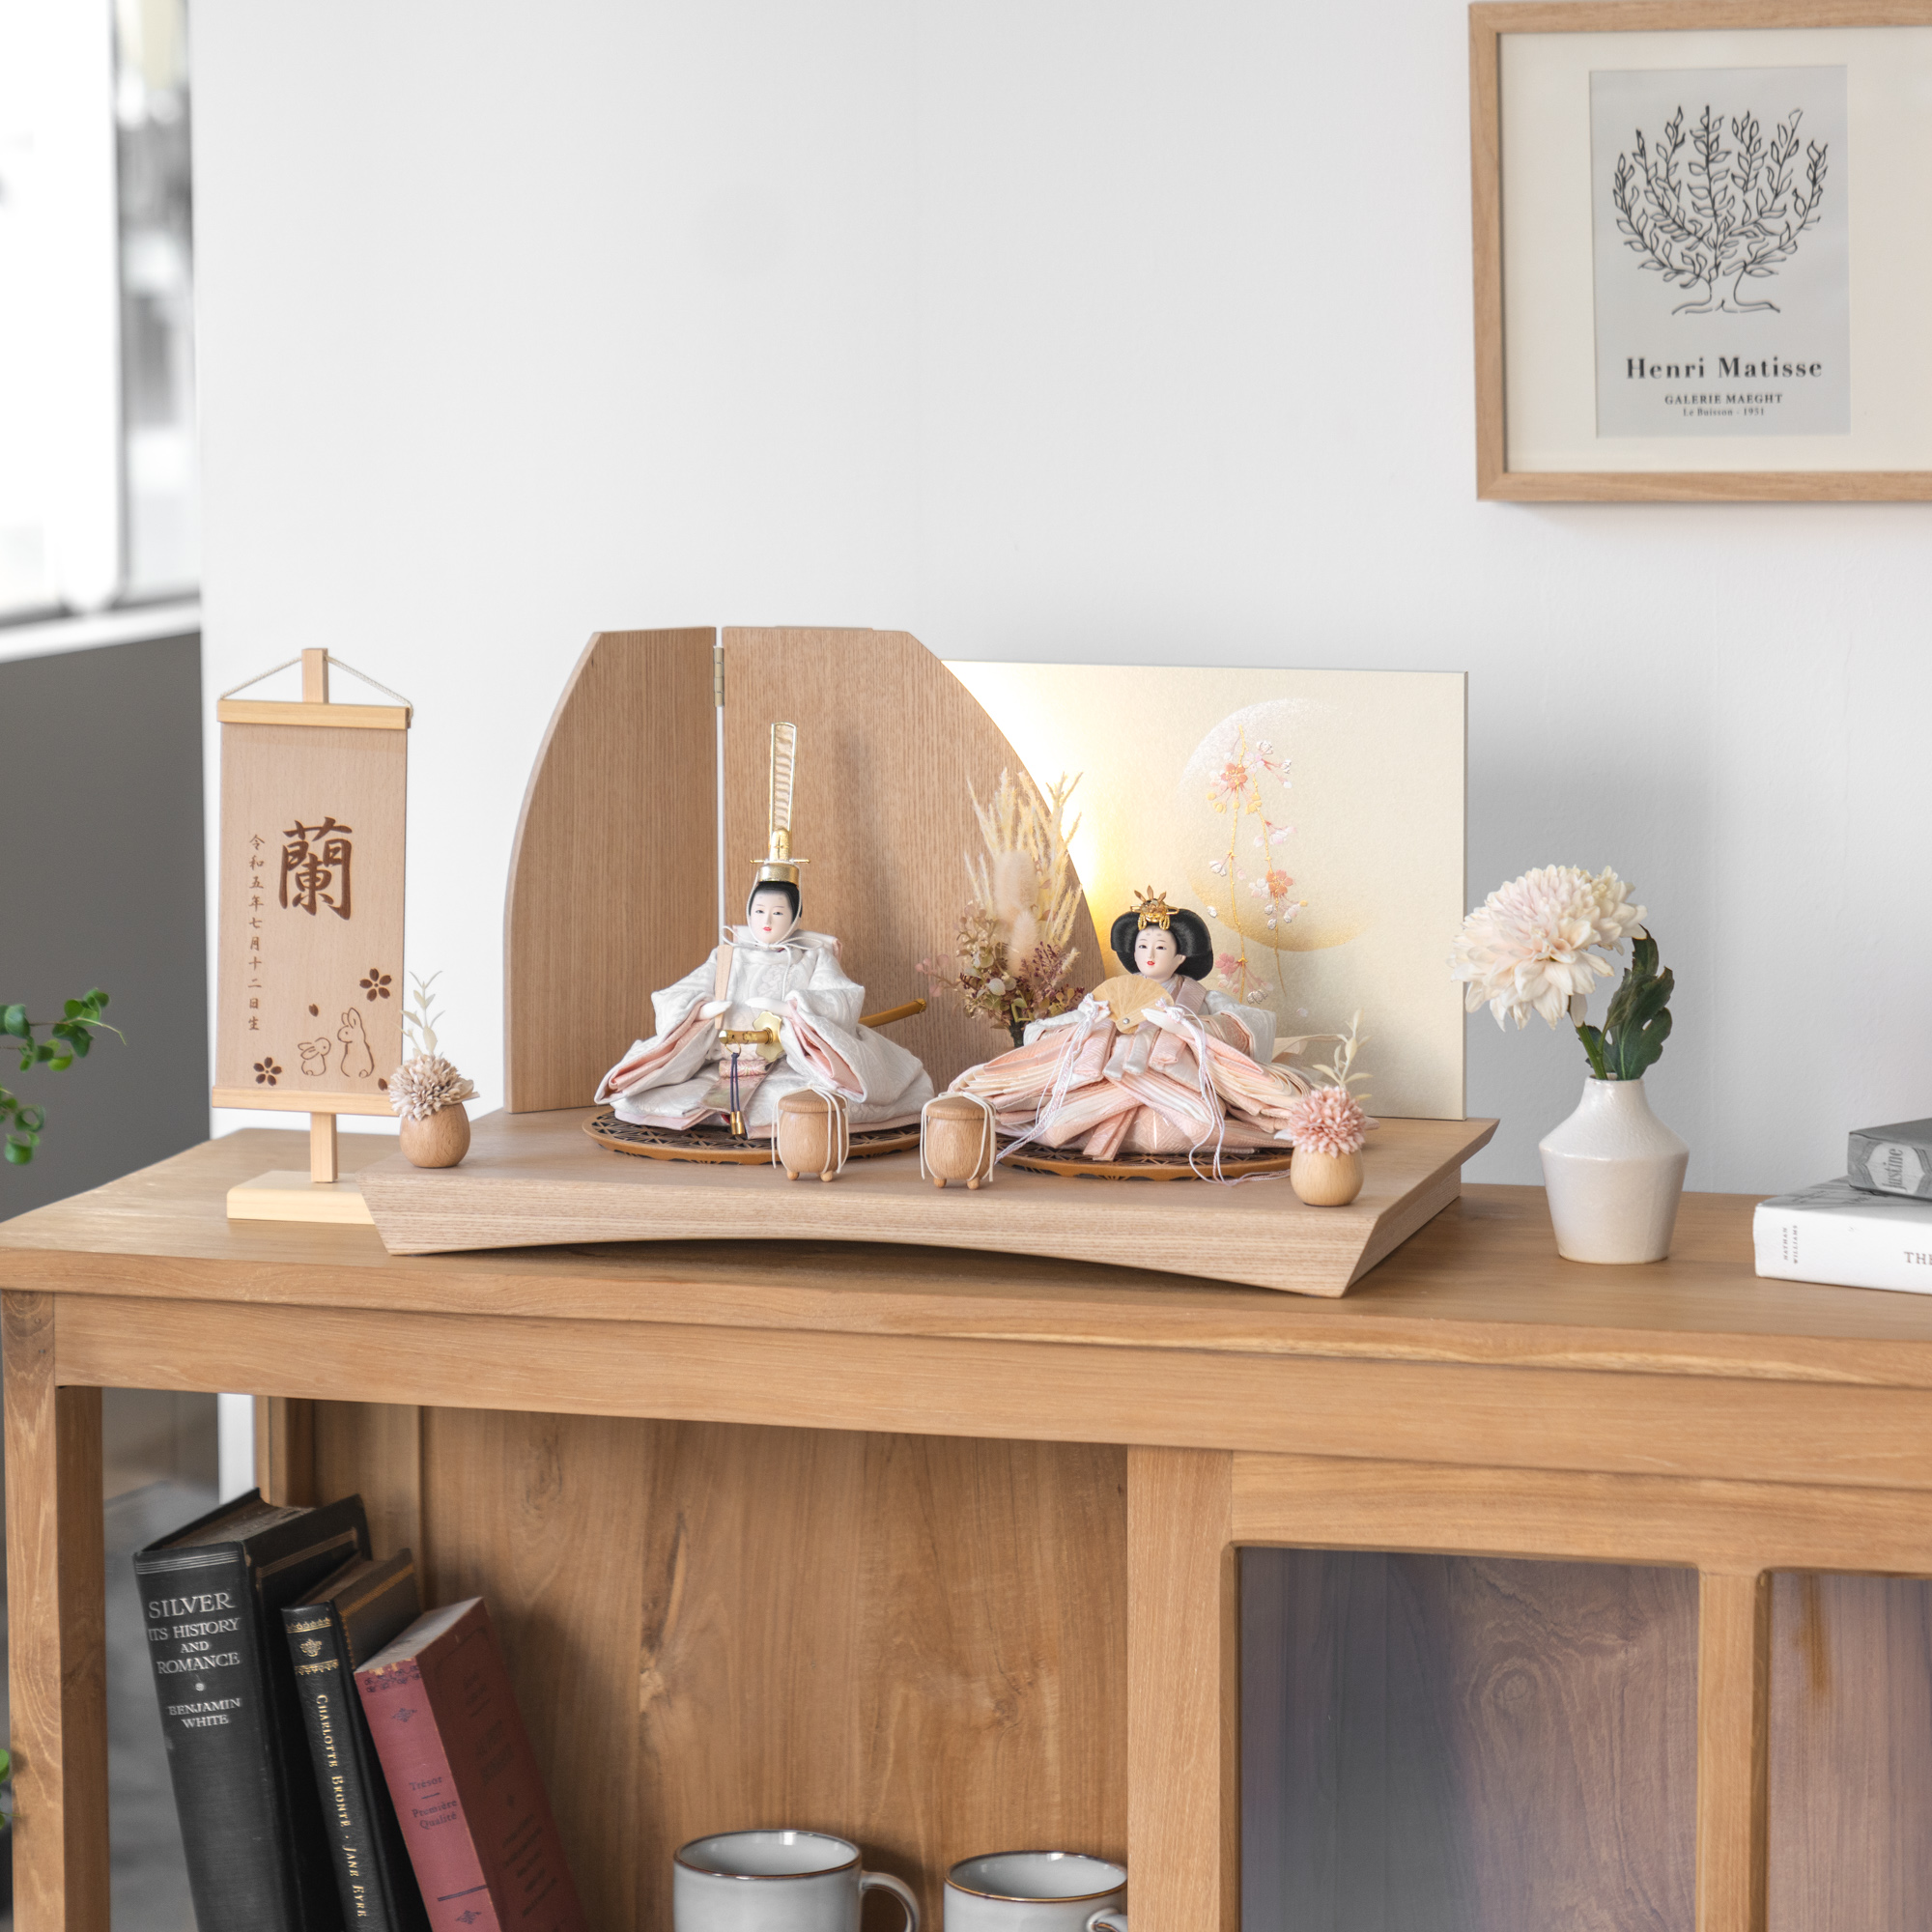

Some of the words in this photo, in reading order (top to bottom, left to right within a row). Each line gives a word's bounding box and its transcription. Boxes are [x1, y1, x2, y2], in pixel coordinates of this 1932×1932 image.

[1627, 356, 1705, 379] Henri
[1719, 355, 1823, 379] Matisse
[1664, 395, 1721, 405] GALERIE
[1725, 394, 1783, 404] MAEGHT
[1683, 408, 1693, 416] Le
[1697, 408, 1733, 416] Buisson
[278, 816, 353, 921] 蘭
[247, 834, 266, 1031] 令和五年七月十二日生
[1882, 1148, 1908, 1194] Justine
[149, 1592, 238, 1619] SILVER
[148, 1628, 169, 1641] ITS
[173, 1617, 241, 1639] HISTORY
[180, 1640, 210, 1653] AND
[156, 1652, 241, 1674] ROMANCE
[168, 1697, 242, 1716] BENJAMIN
[181, 1714, 230, 1729] WHITE
[342, 1845, 359, 1877] JANE
[352, 1885, 366, 1918] EYRE
